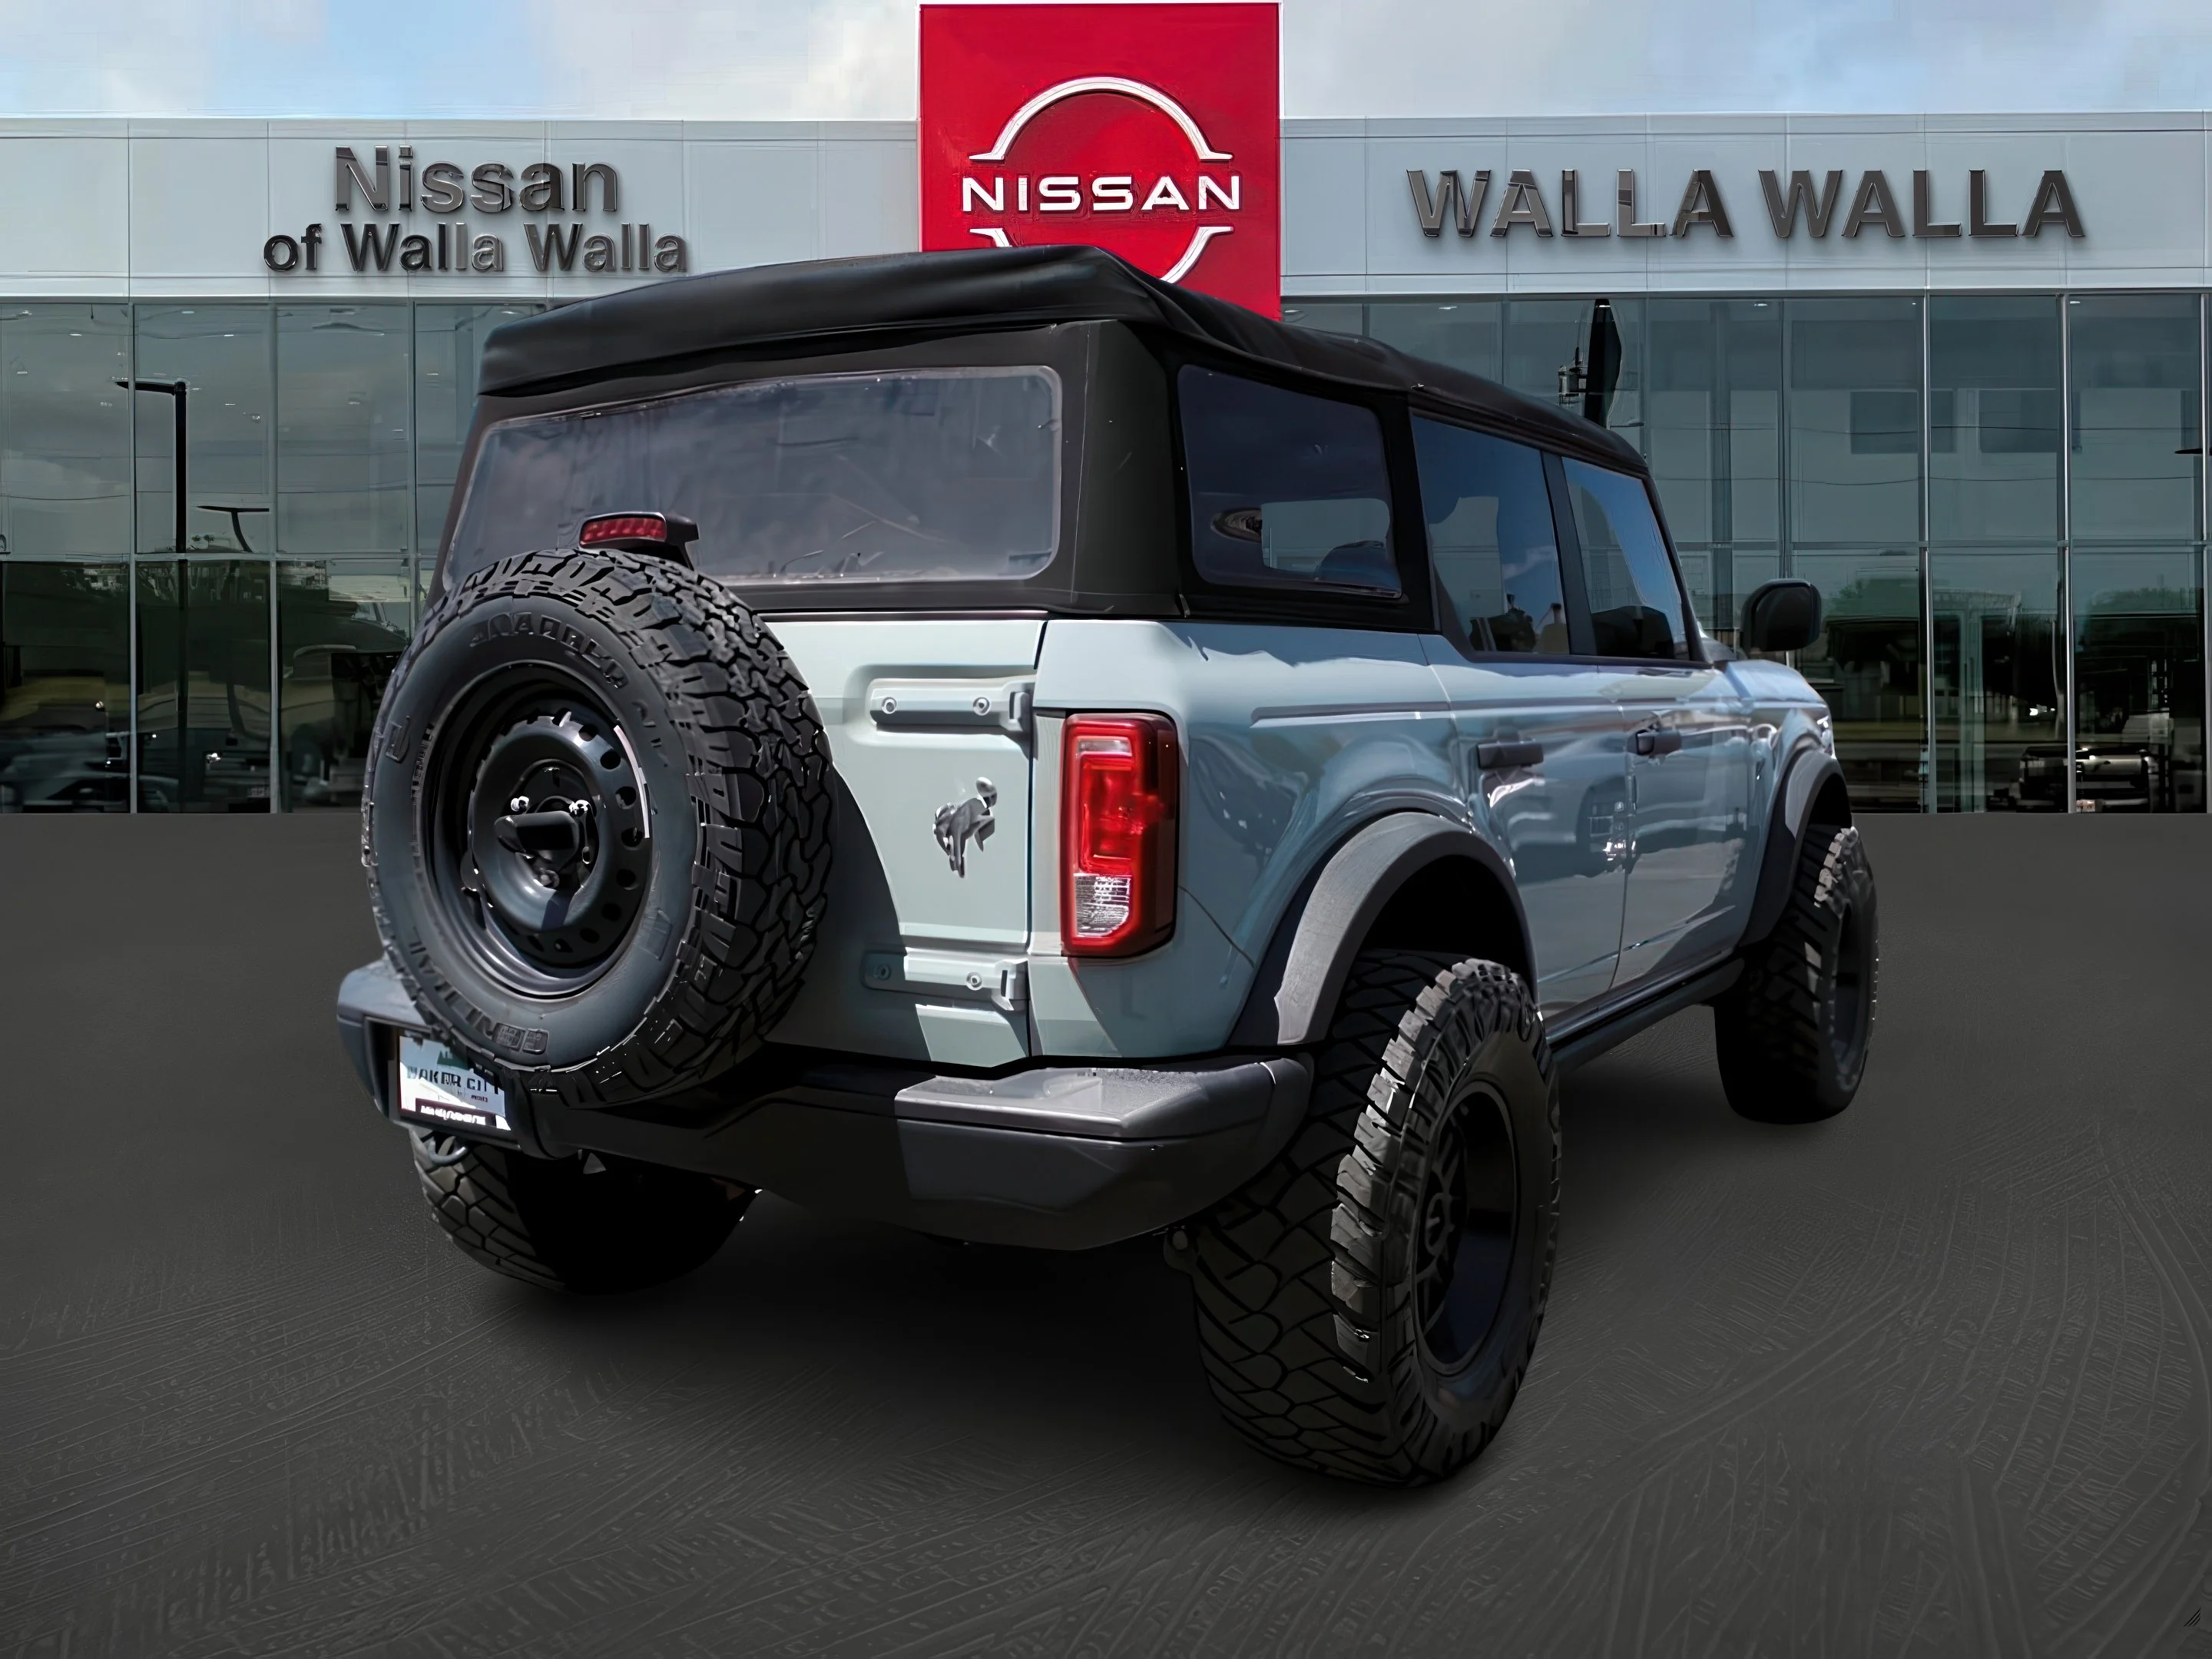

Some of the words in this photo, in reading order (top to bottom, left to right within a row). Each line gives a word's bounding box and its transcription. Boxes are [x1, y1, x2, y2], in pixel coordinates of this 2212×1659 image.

[335, 144, 618, 213] Nissan
[962, 176, 1240, 211] NISSAN
[1406, 169, 1734, 237] WALLA
[1758, 169, 2086, 237] WALLA
[263, 223, 323, 272] of
[340, 223, 503, 272] Walla
[523, 223, 687, 273] Walla
